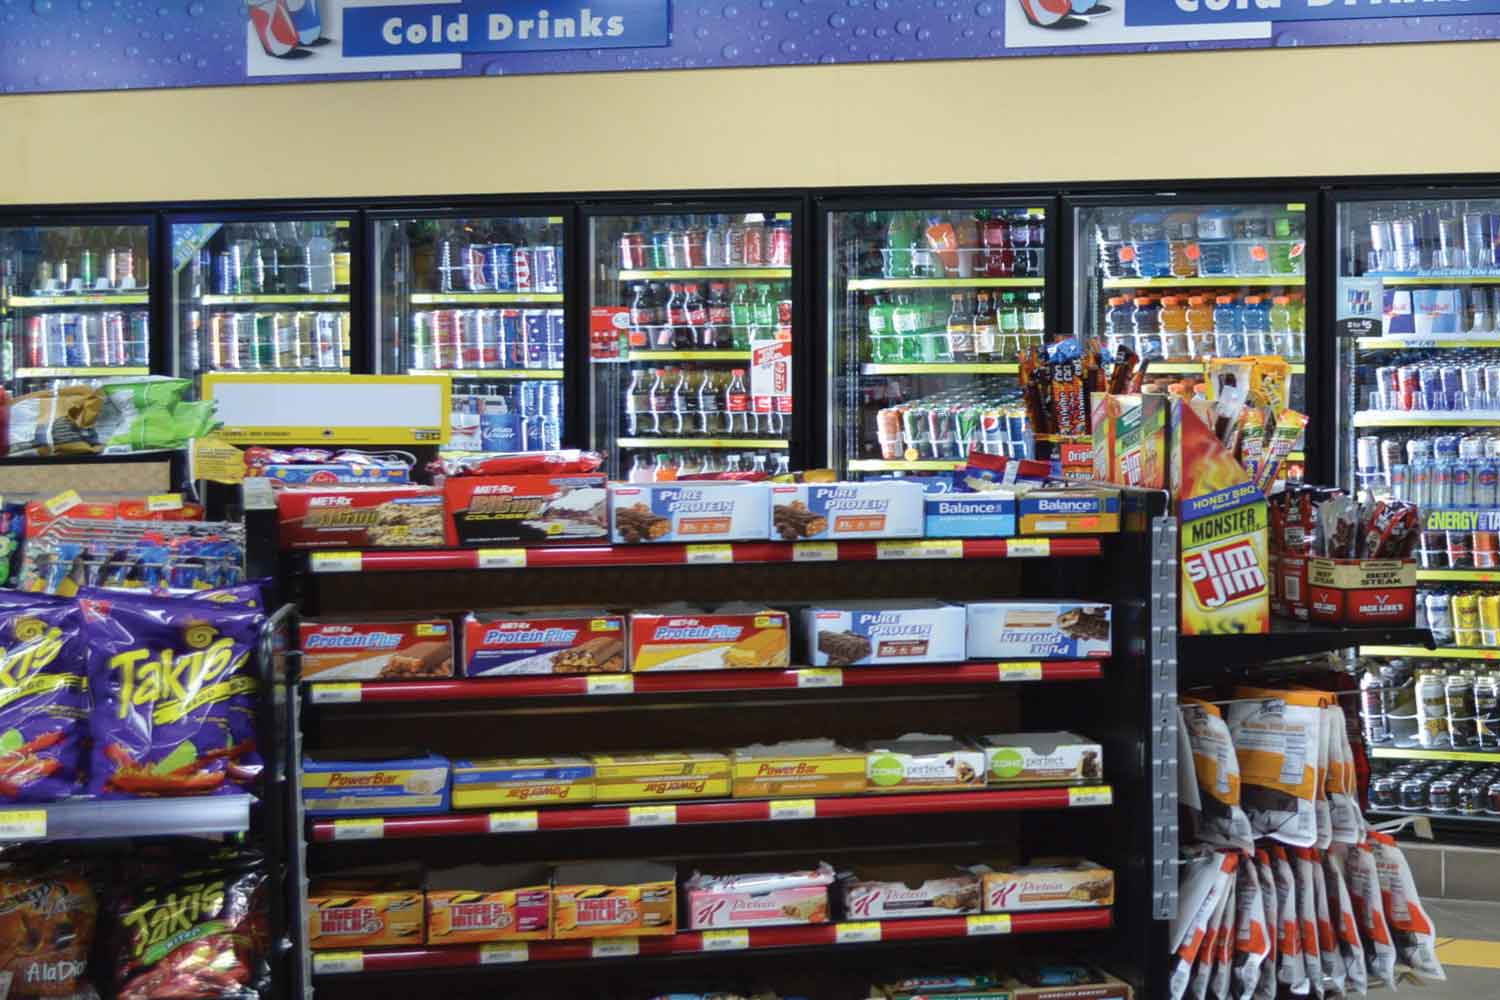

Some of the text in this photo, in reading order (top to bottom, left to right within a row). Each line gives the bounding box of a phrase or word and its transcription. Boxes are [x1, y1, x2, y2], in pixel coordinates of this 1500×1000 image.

[383, 9, 624, 45] Cold Drinks
[659, 490, 703, 501] PURE
[816, 488, 858, 499] PURE
[1193, 492, 1230, 510] HONEY
[1231, 485, 1256, 501] BBQ
[668, 500, 735, 513] PROTEIN
[824, 499, 889, 511] PROTEIN
[939, 502, 994, 514] Balance
[1038, 499, 1092, 511] Balance
[1191, 508, 1256, 543] MONSTER
[860, 613, 903, 625] PURE
[654, 625, 744, 640] Protein Plus
[868, 624, 933, 635] PROTEIN
[305, 632, 404, 648] Protein Plus
[484, 628, 578, 645] Protein Plus
[1000, 630, 1063, 643] PROTEIN
[1030, 643, 1069, 655] PURE
[111, 638, 235, 719] Takis
[1025, 754, 1065, 769] perfect
[757, 762, 819, 776] PowerBar
[328, 773, 397, 788] PowerBar
[506, 786, 570, 799] PowerBar
[643, 781, 705, 794] PowerBar
